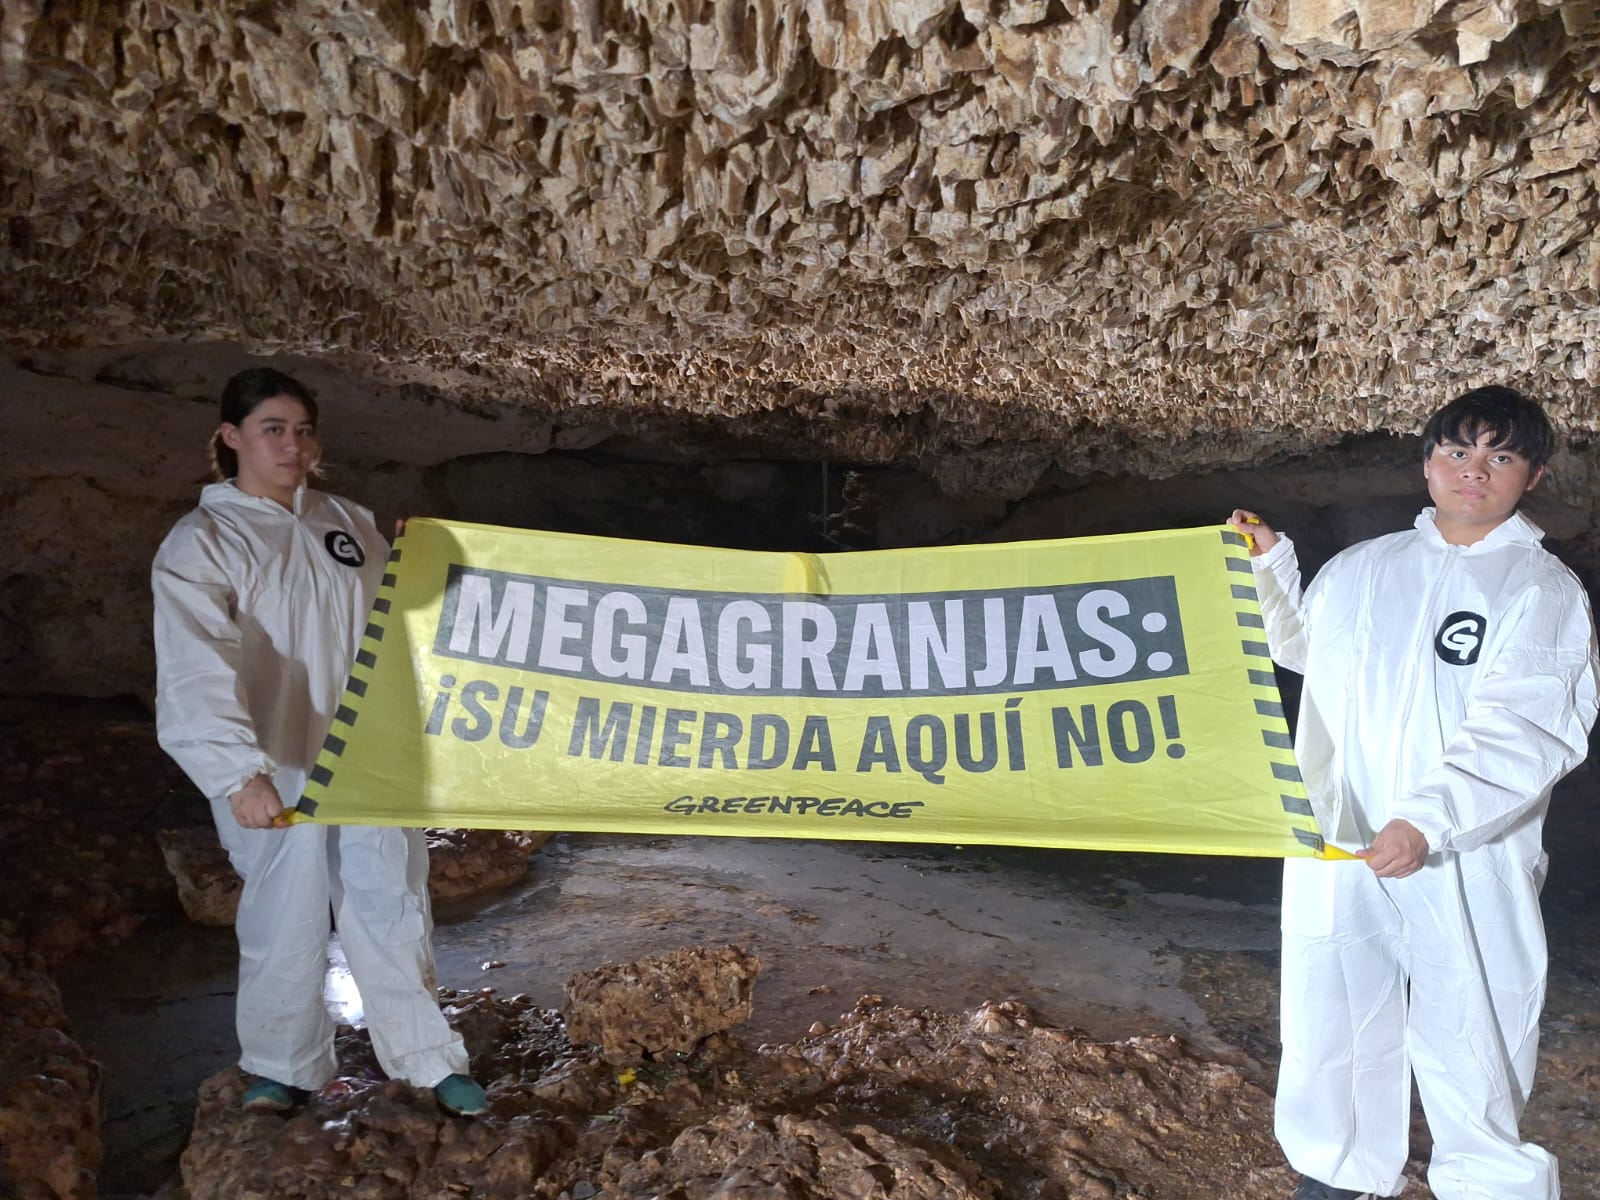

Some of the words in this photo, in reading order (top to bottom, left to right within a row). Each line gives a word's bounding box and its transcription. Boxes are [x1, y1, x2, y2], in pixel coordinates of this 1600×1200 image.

[448, 574, 1174, 691] MEGAGRANJAS:
[424, 674, 550, 749] ¡SU
[567, 697, 837, 772] MIERDA
[856, 697, 1026, 785] AQUÍ
[1051, 694, 1186, 769] NO!
[663, 795, 925, 819] GREENPEACE
